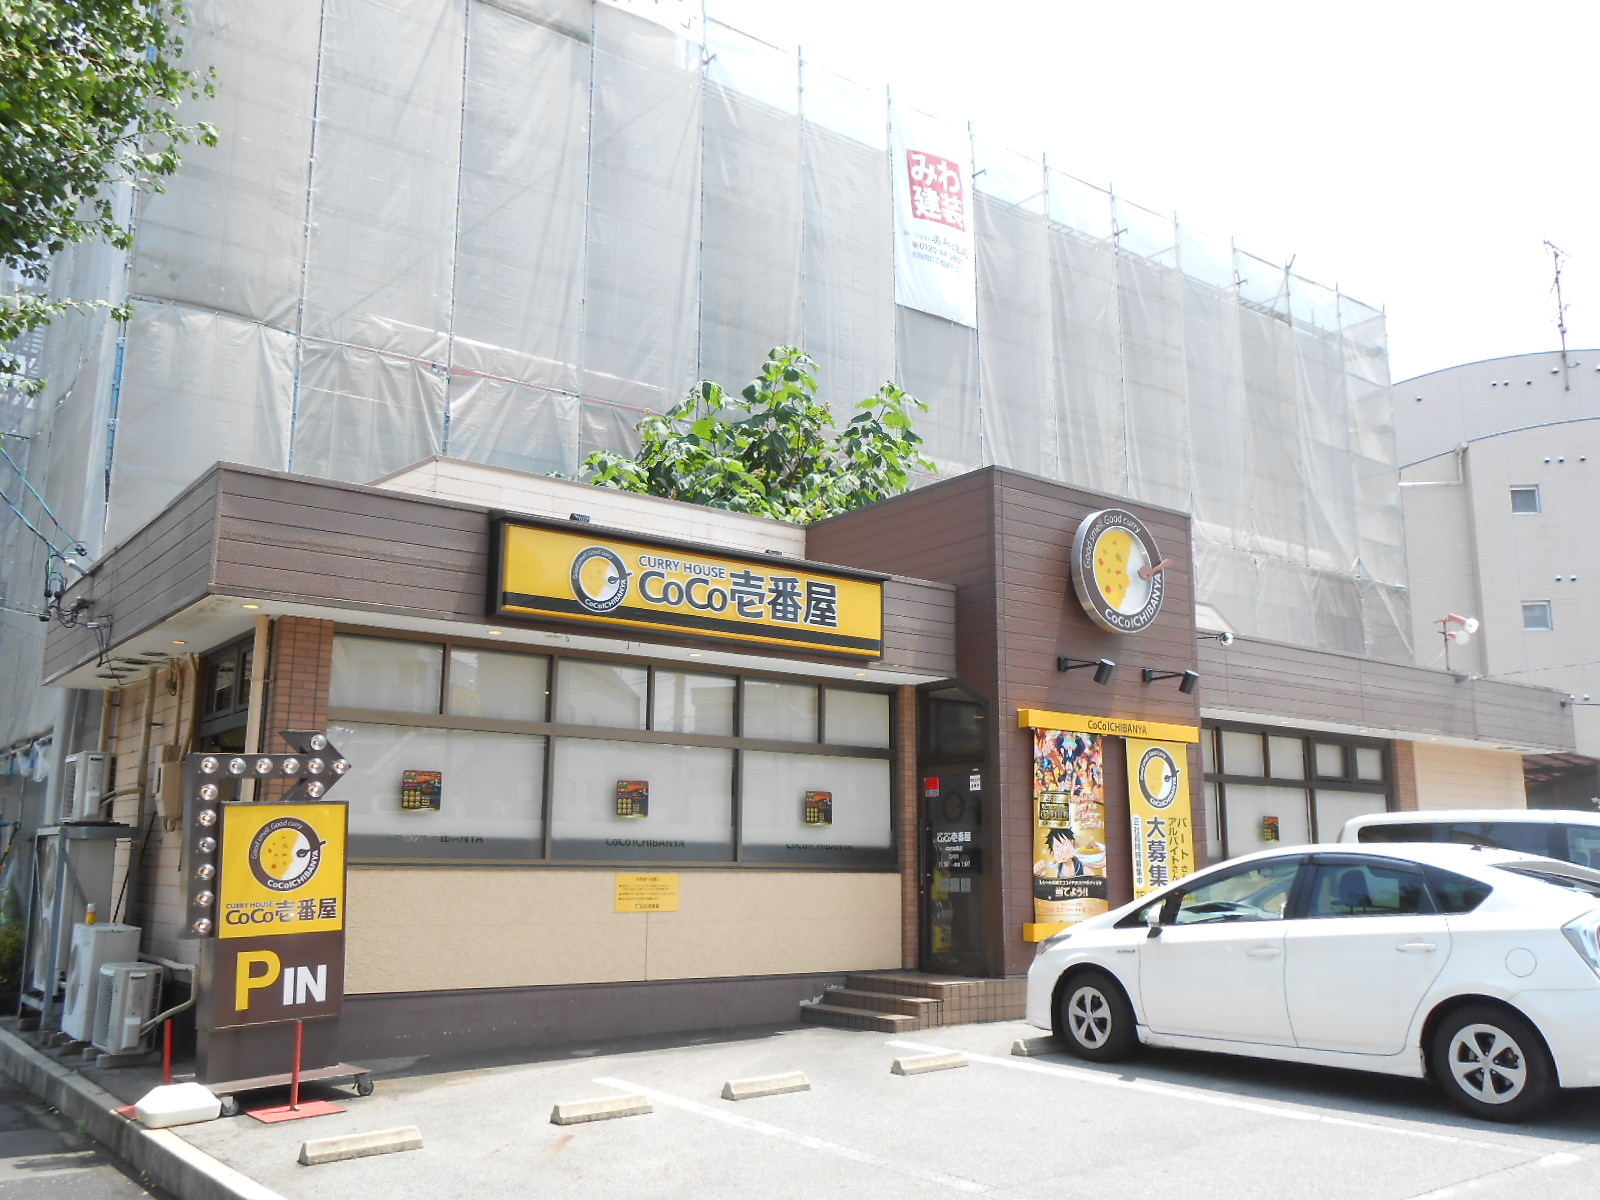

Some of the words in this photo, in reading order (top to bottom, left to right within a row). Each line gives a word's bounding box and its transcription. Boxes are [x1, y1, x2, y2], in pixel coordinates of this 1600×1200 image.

[911, 153, 961, 193] みわ
[913, 185, 965, 228] 建装
[1104, 515, 1121, 525] Good
[1122, 517, 1141, 534] curry
[638, 554, 680, 572] CURRY
[683, 562, 726, 580] HOUSE
[584, 579, 627, 610] CoCoICHIBANYA
[638, 569, 838, 629] CoCo壱番屋
[1104, 573, 1162, 629] CoCoICHIBANYA
[251, 837, 262, 859] Good
[270, 820, 288, 830] Good
[287, 820, 304, 830] curry
[1146, 815, 1169, 887] 大募集
[1168, 817, 1180, 881] アルバイトさん
[267, 849, 320, 890] CoCoICHIBANYA
[225, 902, 249, 910] CURRY
[250, 900, 273, 909] HOUSE
[225, 897, 338, 926] CoCo壱番屋
